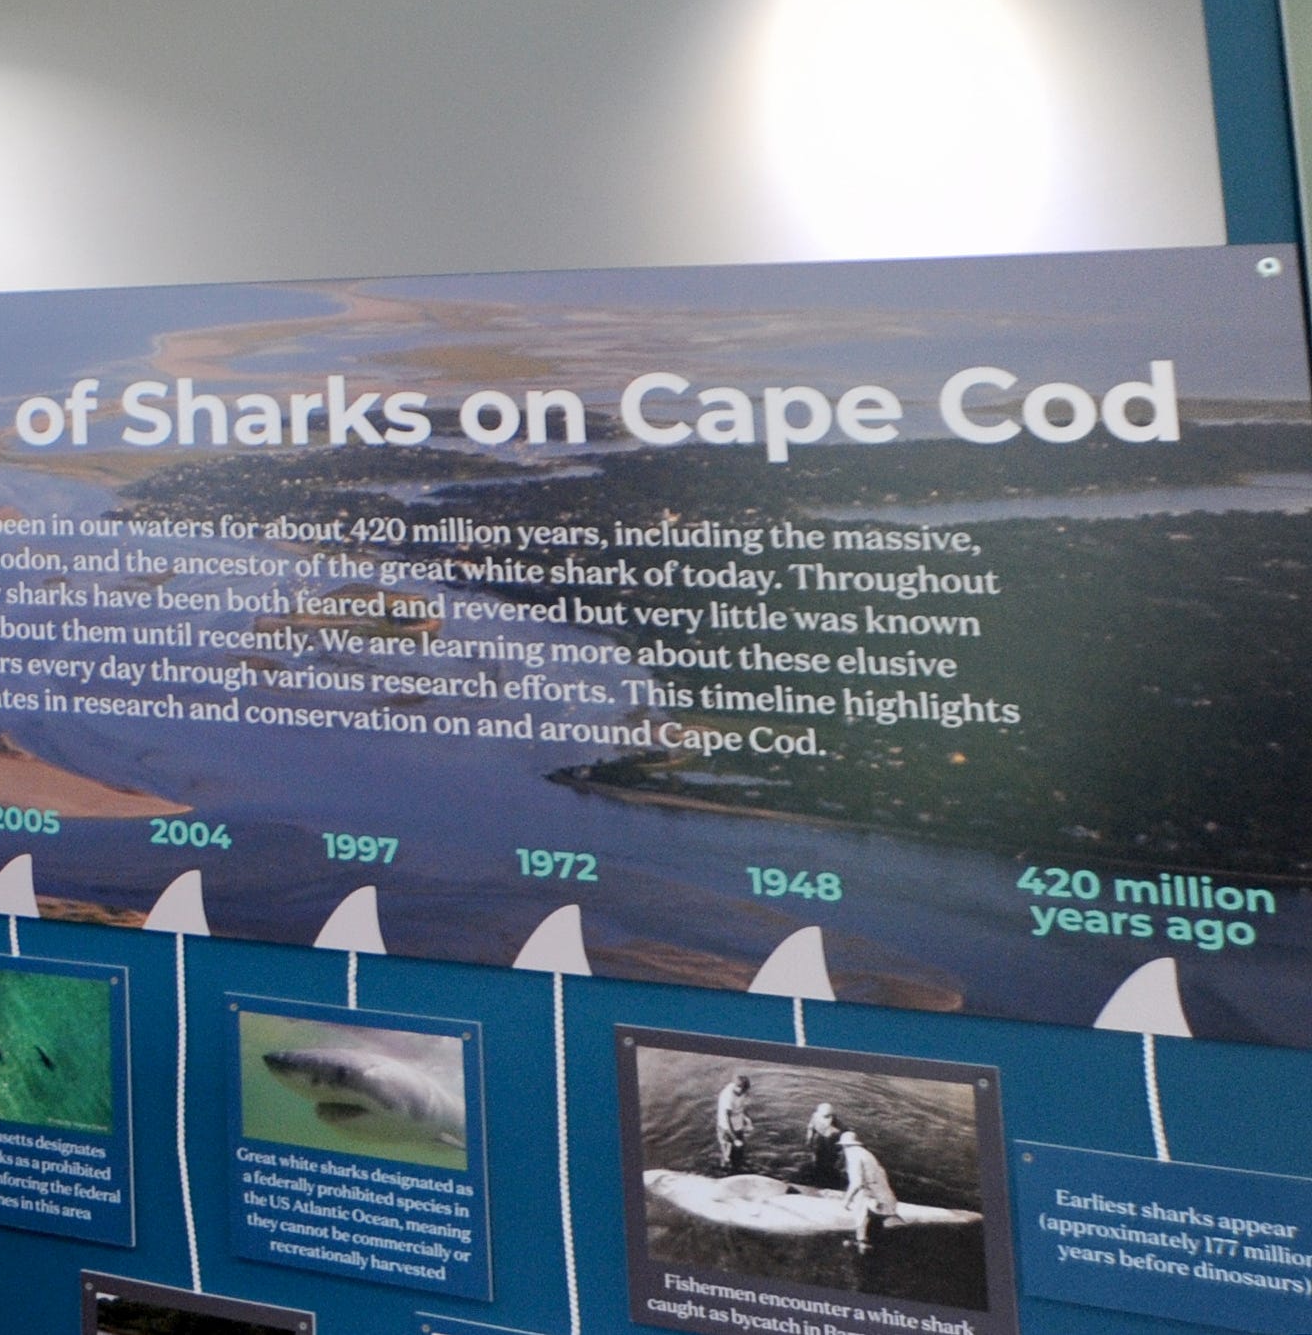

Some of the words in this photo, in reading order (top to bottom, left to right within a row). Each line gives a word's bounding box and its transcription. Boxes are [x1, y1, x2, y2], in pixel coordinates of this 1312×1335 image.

[15, 378, 99, 446] of
[121, 375, 431, 446] Sharks
[459, 386, 587, 446] on
[621, 371, 904, 463] Cape
[939, 359, 1180, 443] Cod
[52, 512, 74, 536] in
[79, 519, 123, 537] our
[126, 514, 214, 539] waters
[220, 515, 259, 540] for
[264, 516, 344, 542] about
[350, 517, 406, 543] 420
[412, 518, 511, 545] million
[517, 527, 609, 554] years,
[615, 521, 763, 557] including
[769, 523, 825, 551] the
[833, 525, 981, 561] massive,
[73, 550, 120, 573] and
[125, 550, 168, 574] the
[173, 553, 290, 578] ancestor
[295, 554, 324, 579] of
[327, 554, 374, 580] the
[380, 557, 456, 587] great
[461, 557, 544, 584] white
[550, 559, 639, 586] shark
[643, 561, 679, 587] of
[683, 561, 782, 597] today.
[788, 563, 1001, 601] Throughout
[6, 582, 88, 607] sharks
[93, 584, 152, 609] have
[157, 586, 221, 611] been
[227, 588, 292, 614] both
[296, 590, 385, 617] feared
[392, 594, 447, 619] and
[452, 597, 568, 623] revered
[574, 598, 628, 625] but
[633, 606, 704, 635] very
[709, 601, 788, 631] little
[793, 611, 858, 633] was
[866, 606, 982, 637] known
[61, 619, 127, 644] them
[131, 622, 192, 647] until
[198, 626, 314, 659] recently.
[319, 628, 363, 654] We
[369, 637, 415, 656] are
[421, 631, 545, 668] learning
[550, 643, 632, 665] more
[637, 640, 733, 669] about
[738, 643, 831, 673] these
[837, 647, 958, 679] elusive
[27, 659, 96, 685] every
[99, 656, 146, 688] day
[150, 658, 257, 693] through
[262, 665, 364, 692] various
[371, 673, 498, 699] research
[504, 674, 615, 704] efforts.
[621, 679, 695, 708] This
[700, 682, 836, 715] timeline
[842, 688, 1021, 729] highlights
[44, 689, 68, 713] in
[73, 696, 184, 720] research
[190, 699, 240, 723] and
[245, 706, 428, 733] conservation
[434, 716, 470, 736] on
[476, 714, 532, 740] and
[539, 721, 651, 747] around
[658, 722, 743, 759] Cape
[748, 726, 827, 756] Cod.
[149, 818, 233, 850] 2004
[322, 832, 400, 865] 1997
[516, 847, 599, 882] 1972
[746, 867, 843, 901] 1948
[1015, 866, 1101, 901] 420
[1114, 874, 1276, 914] million
[1029, 905, 1154, 937] years
[1166, 914, 1256, 950] ago
[15, 1158, 30, 1168] as
[32, 1159, 40, 1169] a
[41, 1160, 112, 1181] prohibited
[35, 1136, 106, 1159] designates
[21, 1196, 34, 1211] in
[35, 1198, 60, 1215] this
[61, 1206, 92, 1220] area
[50, 1181, 72, 1195] the
[74, 1184, 122, 1204] federal
[1055, 1189, 1138, 1216] Earliest
[1141, 1202, 1214, 1227] sharks
[1218, 1216, 1298, 1238] appear
[1039, 1213, 1201, 1255] (approximately
[1205, 1236, 1239, 1257] 177
[1057, 1244, 1116, 1265] years
[1119, 1250, 1191, 1276] before
[1194, 1262, 1312, 1295] dinosaurs)
